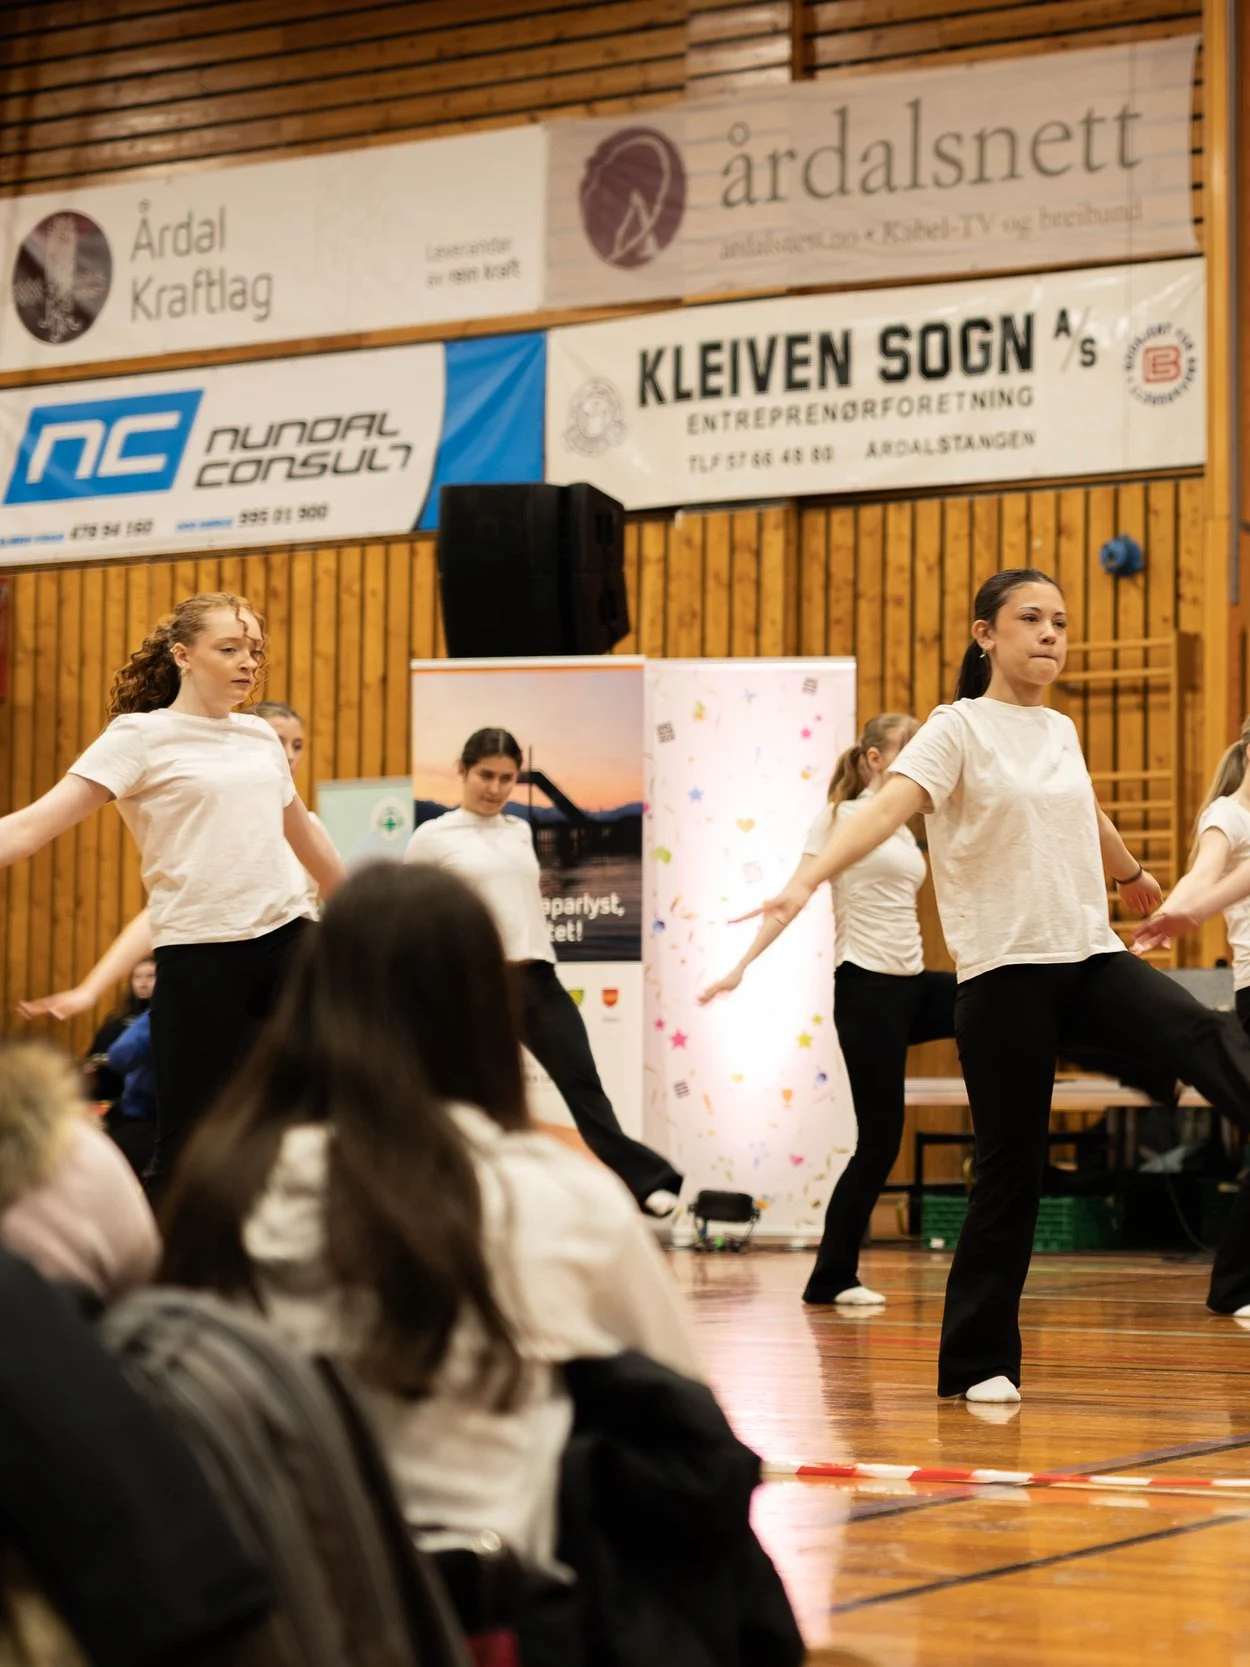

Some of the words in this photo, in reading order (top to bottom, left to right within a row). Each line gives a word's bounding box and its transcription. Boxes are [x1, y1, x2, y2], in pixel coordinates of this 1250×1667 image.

[721, 97, 1143, 210] årdalsnett
[130, 198, 227, 263] Årdal
[882, 211, 998, 246] Kabel-TV
[1001, 214, 1033, 240] og
[131, 265, 274, 323] Kraftlag
[638, 328, 853, 408] KLEIVEN
[877, 312, 1035, 383] SOGN
[687, 385, 1034, 435] ENTREPRENØRFORETNING
[194, 443, 412, 489] CONSULT
[688, 452, 722, 474] TLF
[541, 892, 625, 920] aparlyst,
